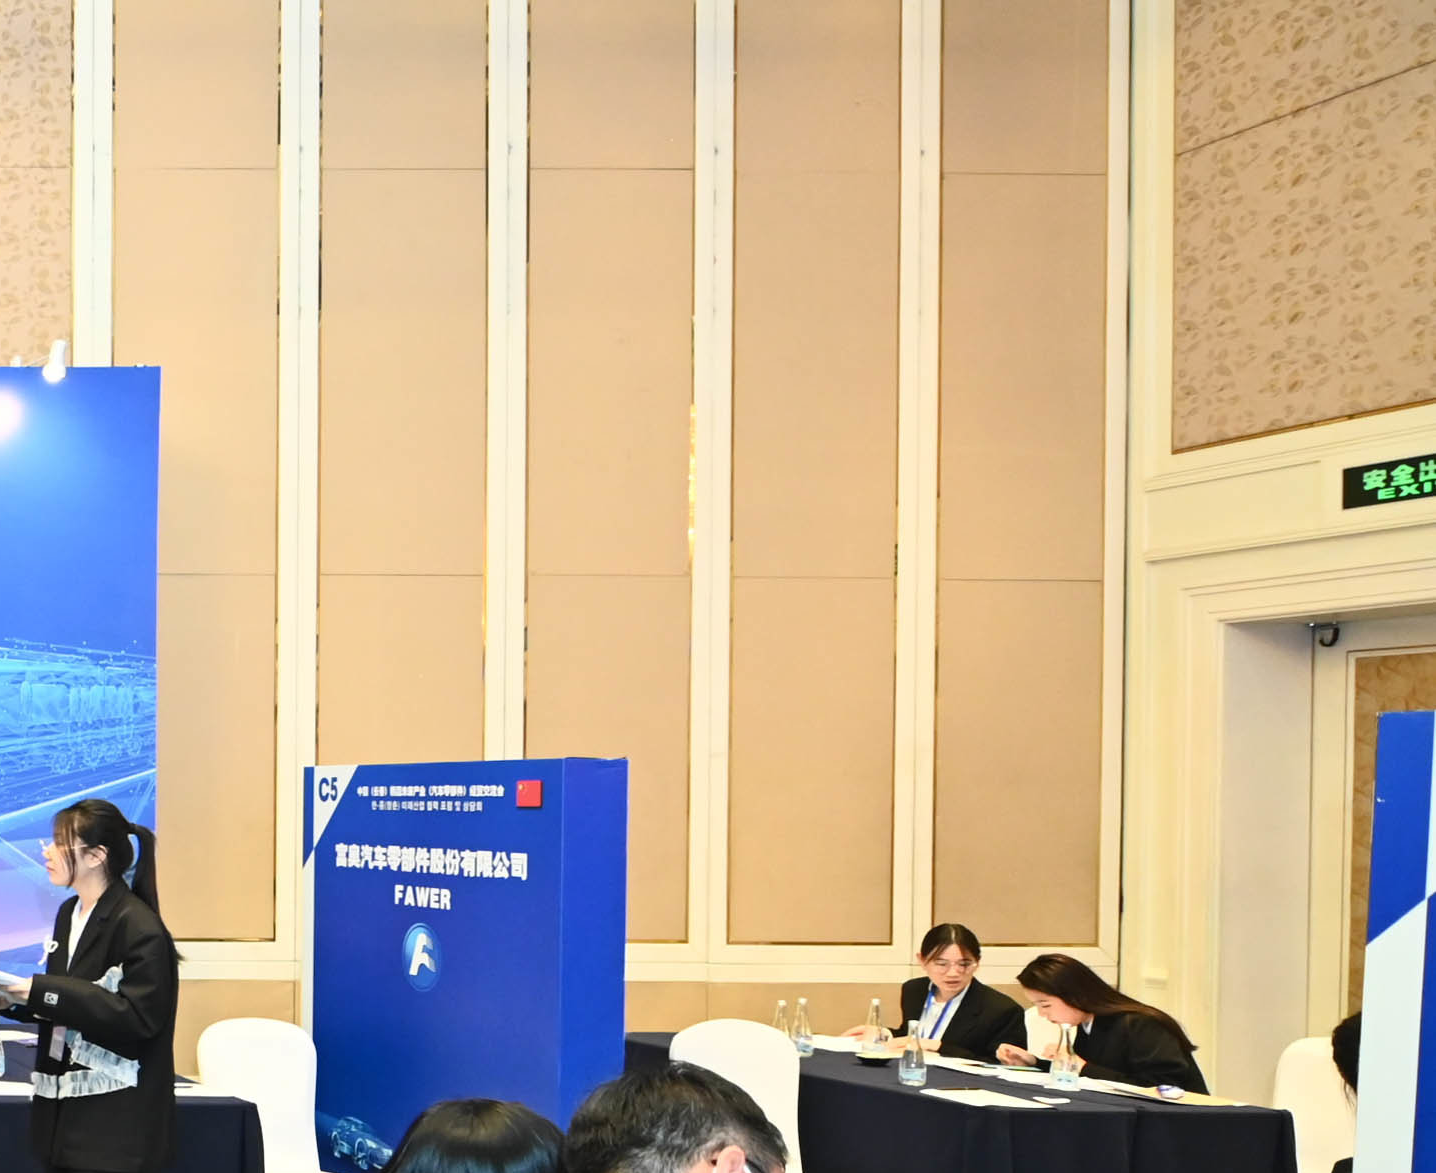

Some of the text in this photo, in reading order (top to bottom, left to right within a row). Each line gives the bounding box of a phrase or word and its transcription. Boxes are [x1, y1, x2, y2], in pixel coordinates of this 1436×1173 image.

[1377, 480, 1436, 500] EXI
[319, 777, 338, 802] C5
[335, 843, 529, 881] 富奥汽车零部件股份有限公司
[394, 884, 451, 911] FAWER
